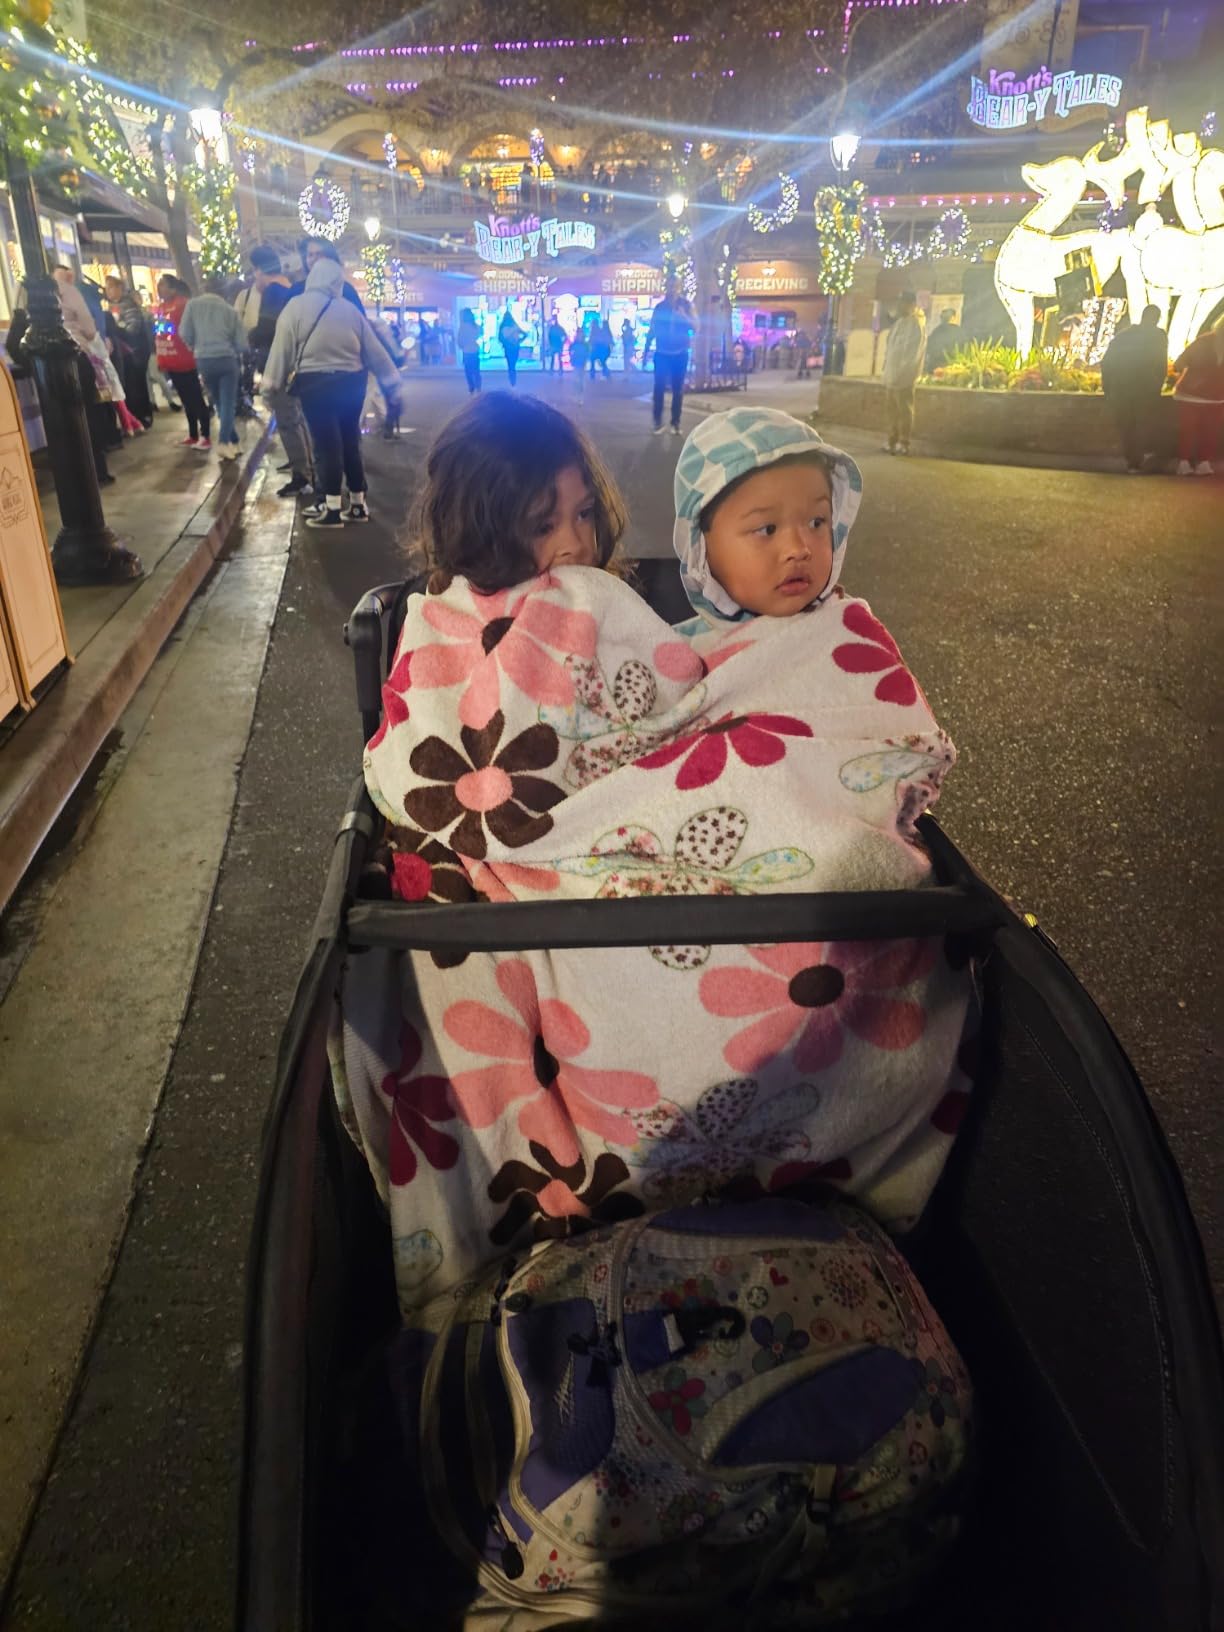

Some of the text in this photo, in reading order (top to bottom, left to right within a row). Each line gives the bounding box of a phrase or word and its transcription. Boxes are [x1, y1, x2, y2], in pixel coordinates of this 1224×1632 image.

[988, 65, 1053, 97] Knott's
[967, 70, 1123, 129] BEAR-Y TALES
[487, 213, 541, 238] Knott's
[541, 217, 596, 258] TALES
[601, 279, 662, 293] SHIPPIN
[734, 277, 809, 290] RECEIVING
